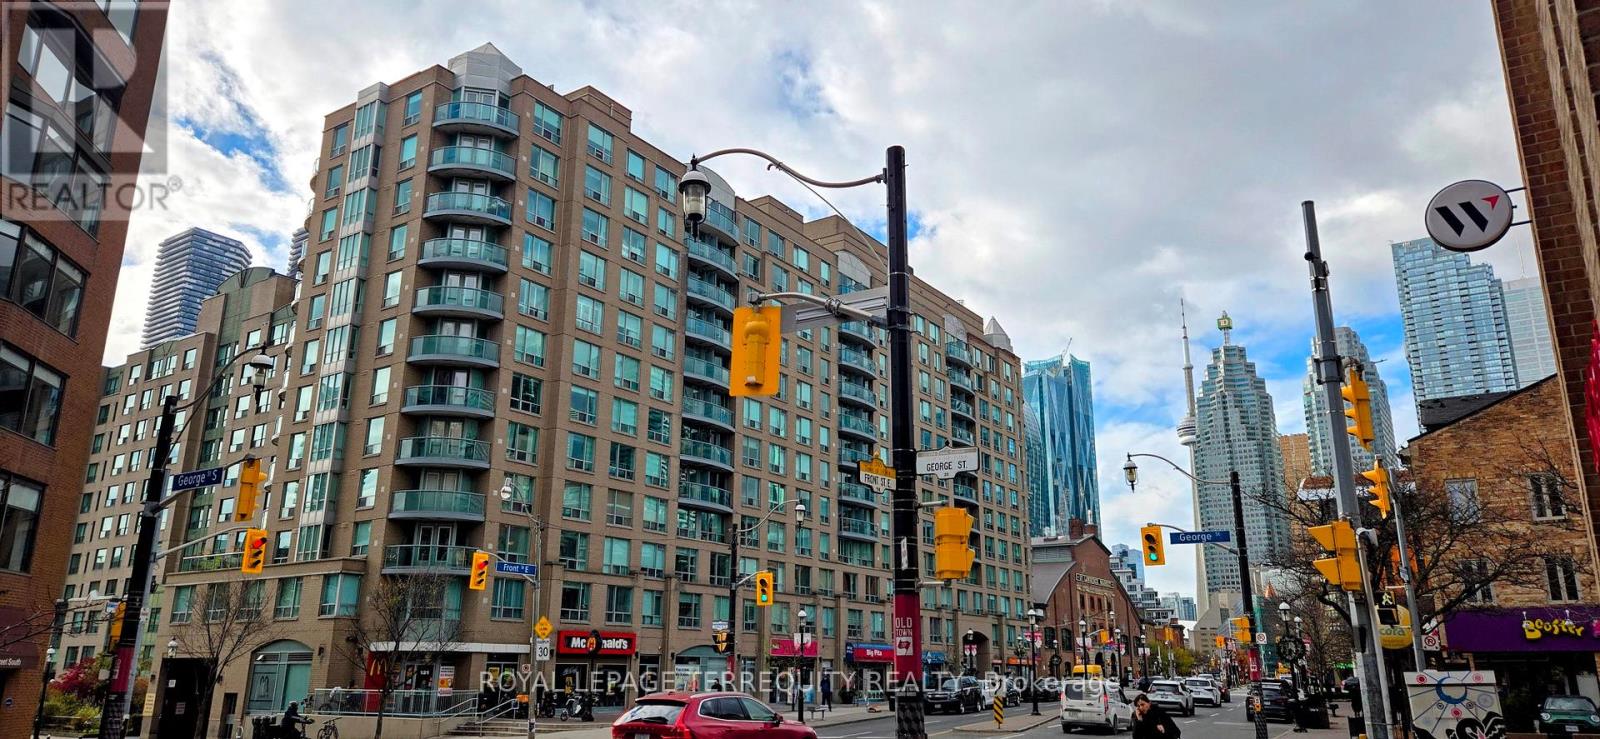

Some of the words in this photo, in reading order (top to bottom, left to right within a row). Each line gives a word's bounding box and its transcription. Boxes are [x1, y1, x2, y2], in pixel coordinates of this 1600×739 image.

[926, 462, 953, 472] GEORGE
[178, 473, 206, 487] George
[212, 469, 218, 481] S
[864, 473, 879, 485] FRONT
[1180, 533, 1212, 543] George
[503, 563, 519, 572] Front
[524, 565, 530, 573] E
[895, 617, 913, 629] OLD
[895, 628, 913, 637] TOWN
[570, 636, 628, 650] Mcnald's
[538, 646, 549, 658] 30
[8, 658, 22, 666] South
